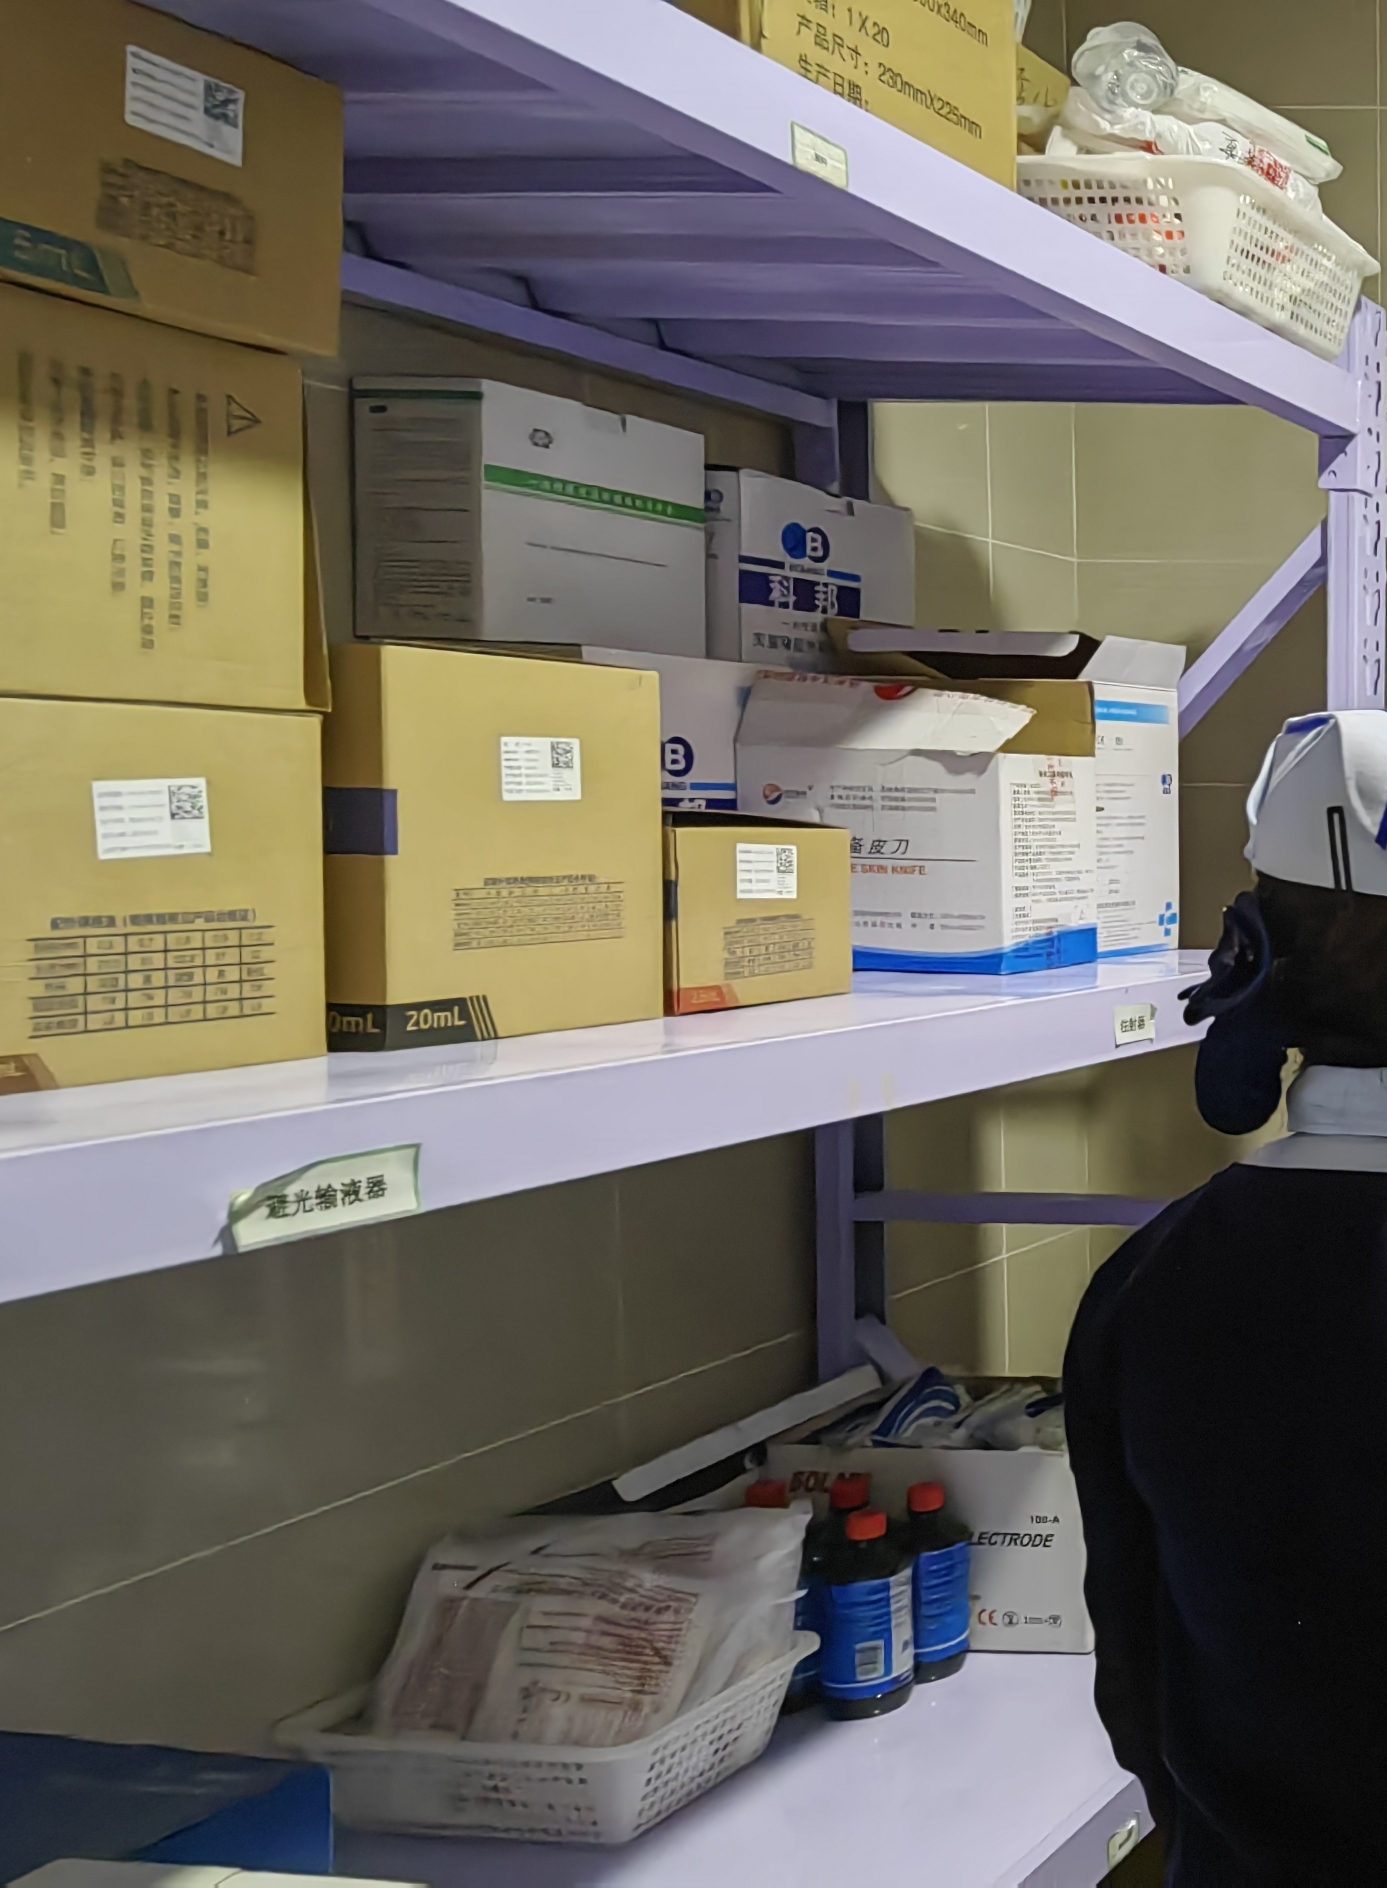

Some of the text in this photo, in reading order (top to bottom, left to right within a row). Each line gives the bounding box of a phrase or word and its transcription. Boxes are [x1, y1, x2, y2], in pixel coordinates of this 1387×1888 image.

[769, 576, 839, 616] 科邦
[861, 863, 888, 875] SKIN
[892, 865, 927, 876] KNIFE
[405, 1005, 467, 1031] 20mL
[265, 1174, 388, 1220] 避光输液器
